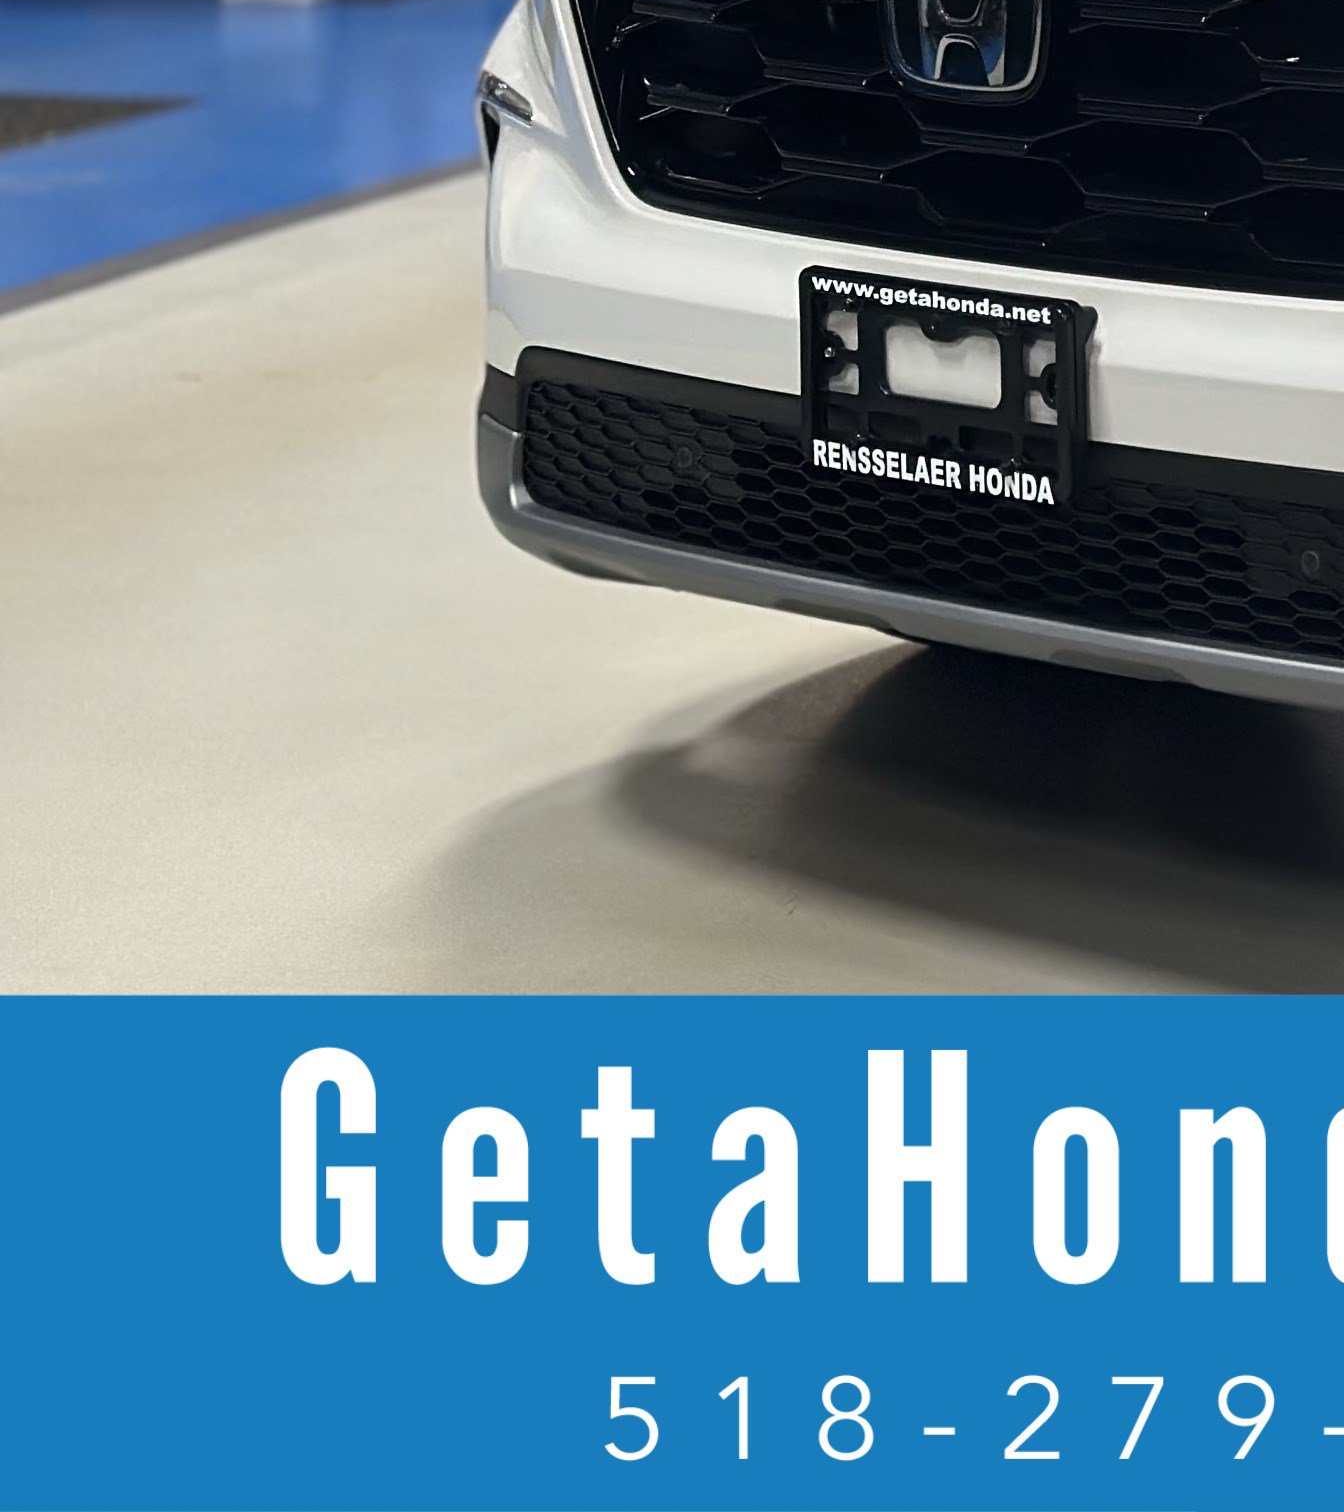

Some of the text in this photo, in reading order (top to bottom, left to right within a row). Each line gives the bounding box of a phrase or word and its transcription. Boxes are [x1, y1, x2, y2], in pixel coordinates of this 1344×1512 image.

[811, 275, 1052, 325] www.getahonda.net
[812, 438, 1055, 505] RENSSELAER HONDA
